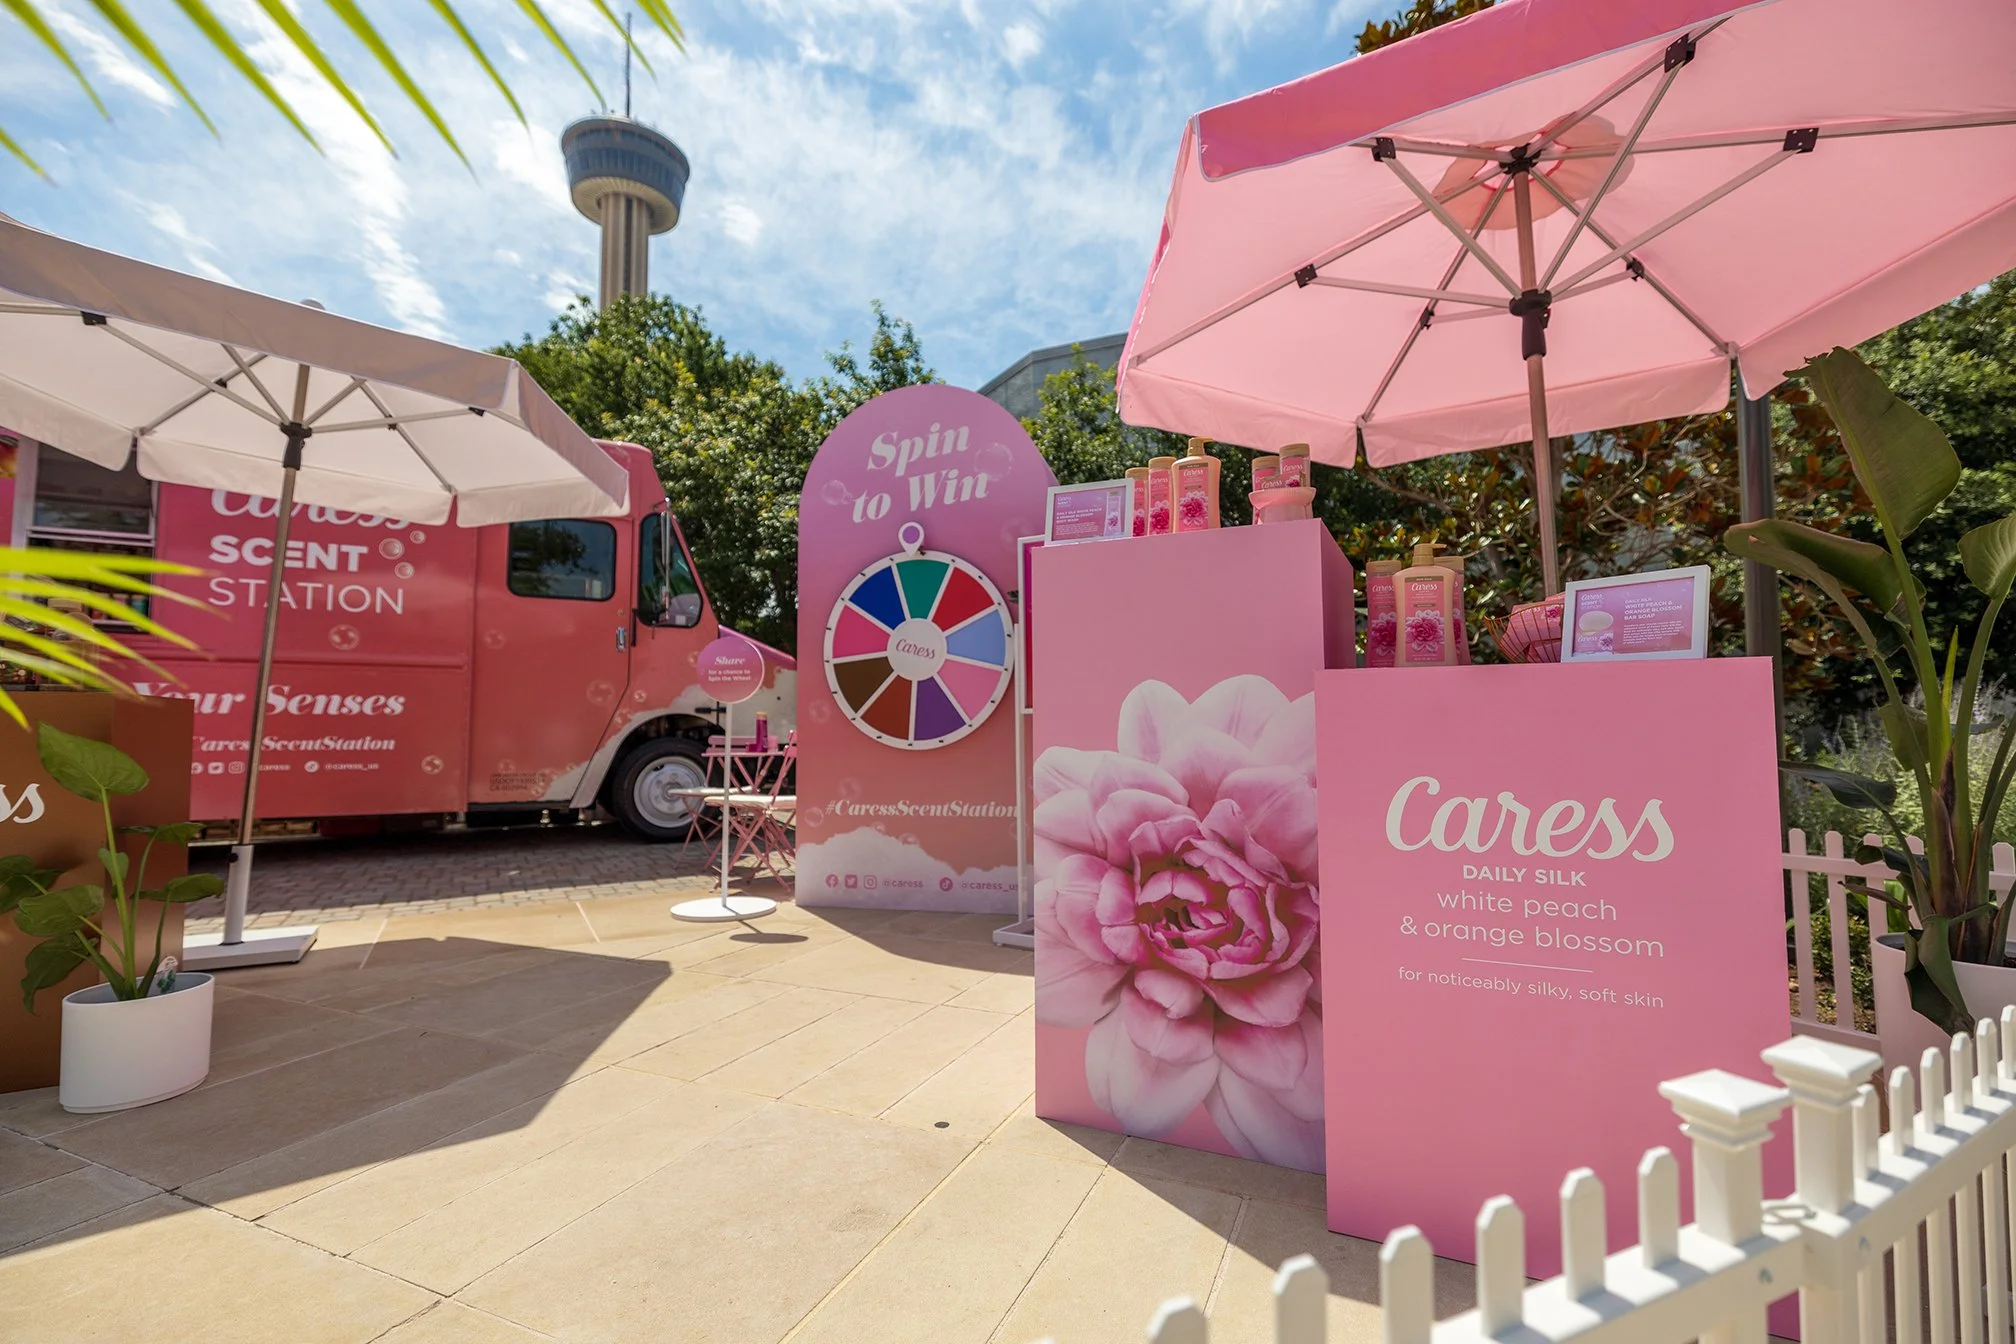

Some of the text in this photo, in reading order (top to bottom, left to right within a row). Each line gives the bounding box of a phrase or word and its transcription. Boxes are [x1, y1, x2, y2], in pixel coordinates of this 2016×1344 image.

[867, 423, 970, 477] Spin
[852, 468, 989, 523] to Win
[208, 534, 368, 572] SCENT
[208, 576, 404, 614] STATION
[1411, 583, 1437, 592] Caress
[1651, 605, 1682, 613] BLOSSOM
[714, 656, 746, 665] Share
[895, 638, 935, 660] Caress
[266, 685, 405, 715] Senses
[824, 799, 1018, 818] #CaressScentStation
[1385, 775, 1675, 862] Caress
[884, 879, 924, 889] @caress
[1462, 865, 1587, 887] DAILY SILK
[1436, 890, 1618, 921] white peach
[1399, 916, 1665, 958] & orange blossom
[1398, 966, 1664, 1008] for noticeably silky, soft skin
